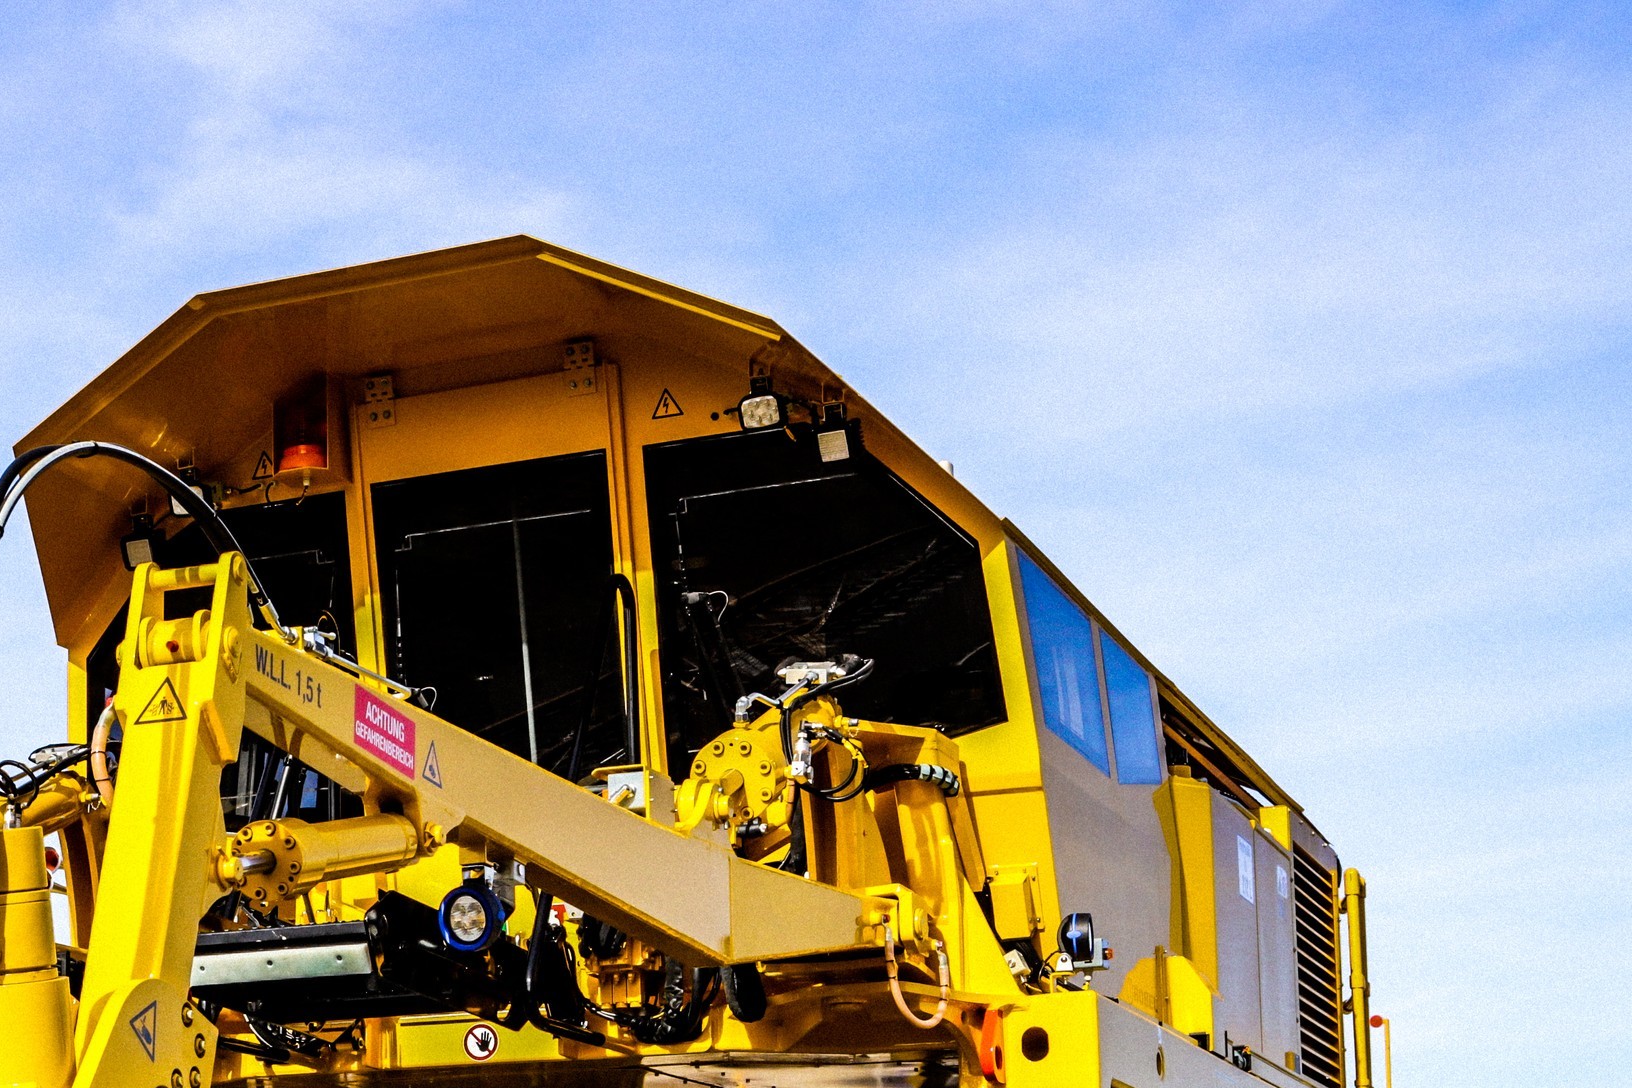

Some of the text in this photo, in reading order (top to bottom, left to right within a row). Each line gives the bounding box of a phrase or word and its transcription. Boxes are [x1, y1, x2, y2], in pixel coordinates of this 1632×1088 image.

[255, 644, 322, 708] W.L.L. 1,5 t
[355, 720, 414, 769] GEFAHRENBEREICH
[365, 701, 405, 743] ACHTUNG
